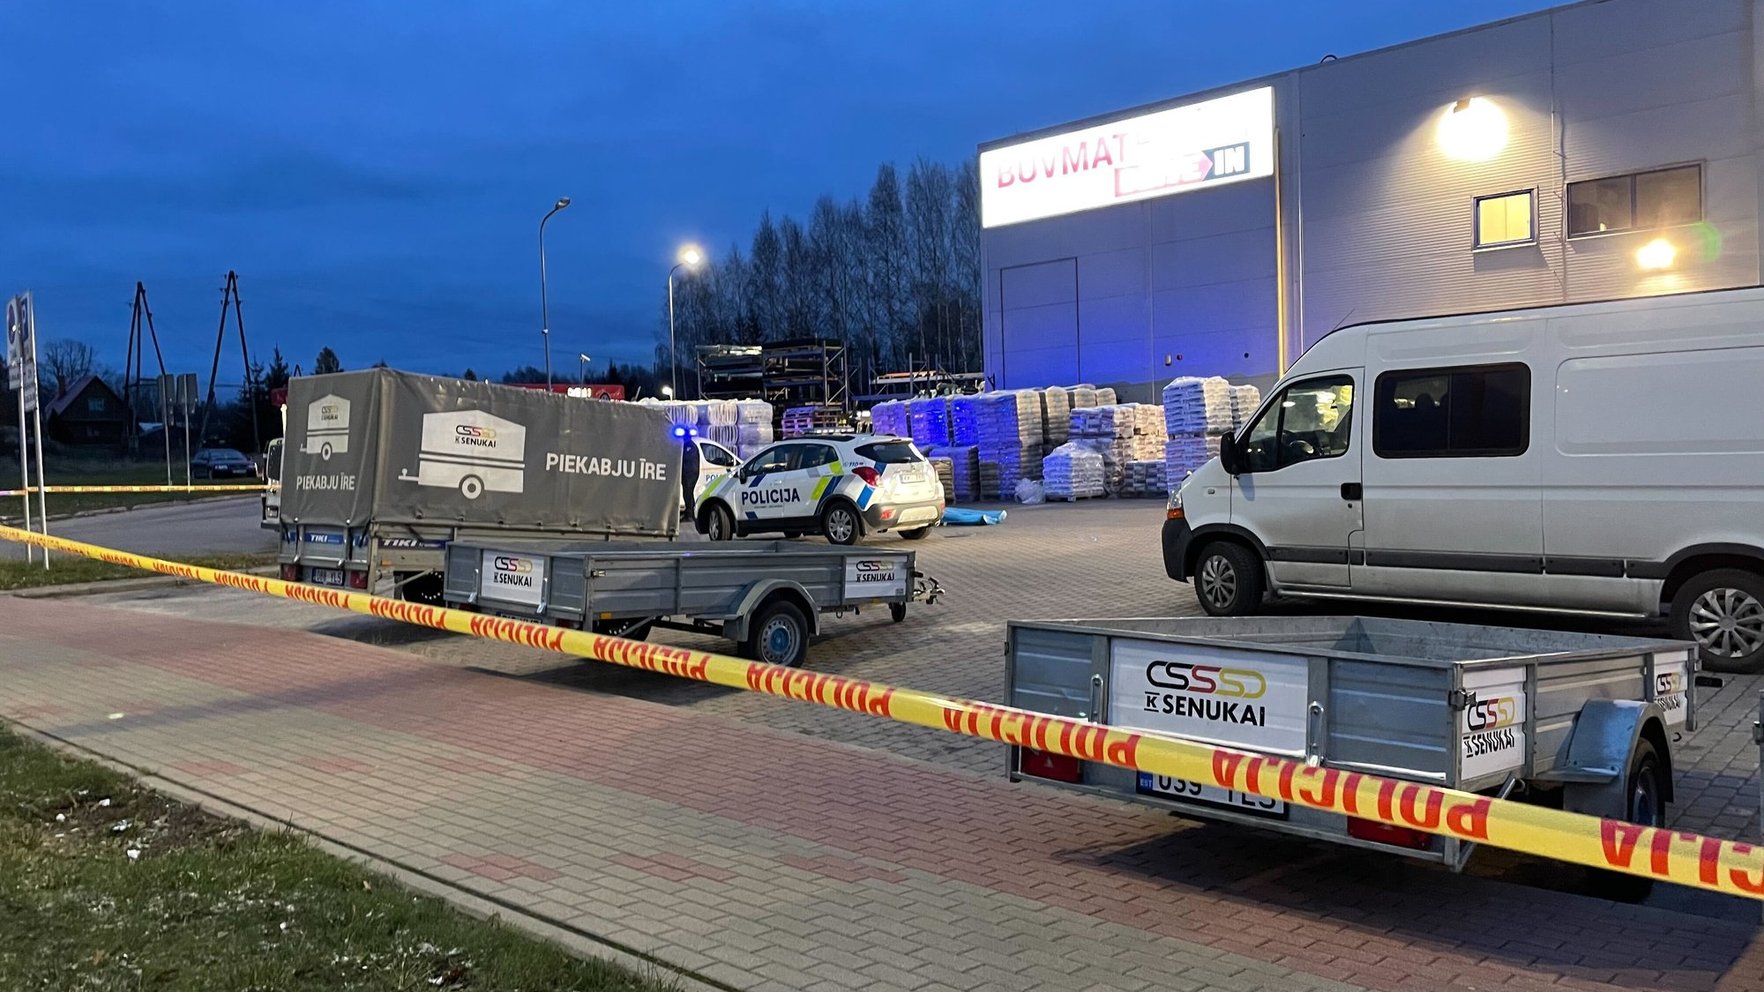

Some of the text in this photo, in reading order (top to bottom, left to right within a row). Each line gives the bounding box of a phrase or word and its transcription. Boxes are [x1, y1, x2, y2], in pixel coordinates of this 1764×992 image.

[1214, 146, 1246, 175] IN
[461, 437, 497, 448] SENUKAI
[545, 452, 667, 480] PIEKABJU ĪRE
[296, 472, 355, 490] PIEKABJU ĪRE
[741, 488, 801, 505] POLICIJA
[310, 534, 328, 542] TIKI
[383, 537, 418, 547] TIKI
[500, 573, 532, 588] SENUKAI
[862, 572, 895, 582] SENUKAI
[746, 663, 894, 717] POLICIJA
[1162, 694, 1266, 727] SENUKAI
[944, 699, 1141, 769] POLICIJA
[1471, 728, 1515, 756] SENUKAI
[1211, 748, 1490, 840] POLICIJA
